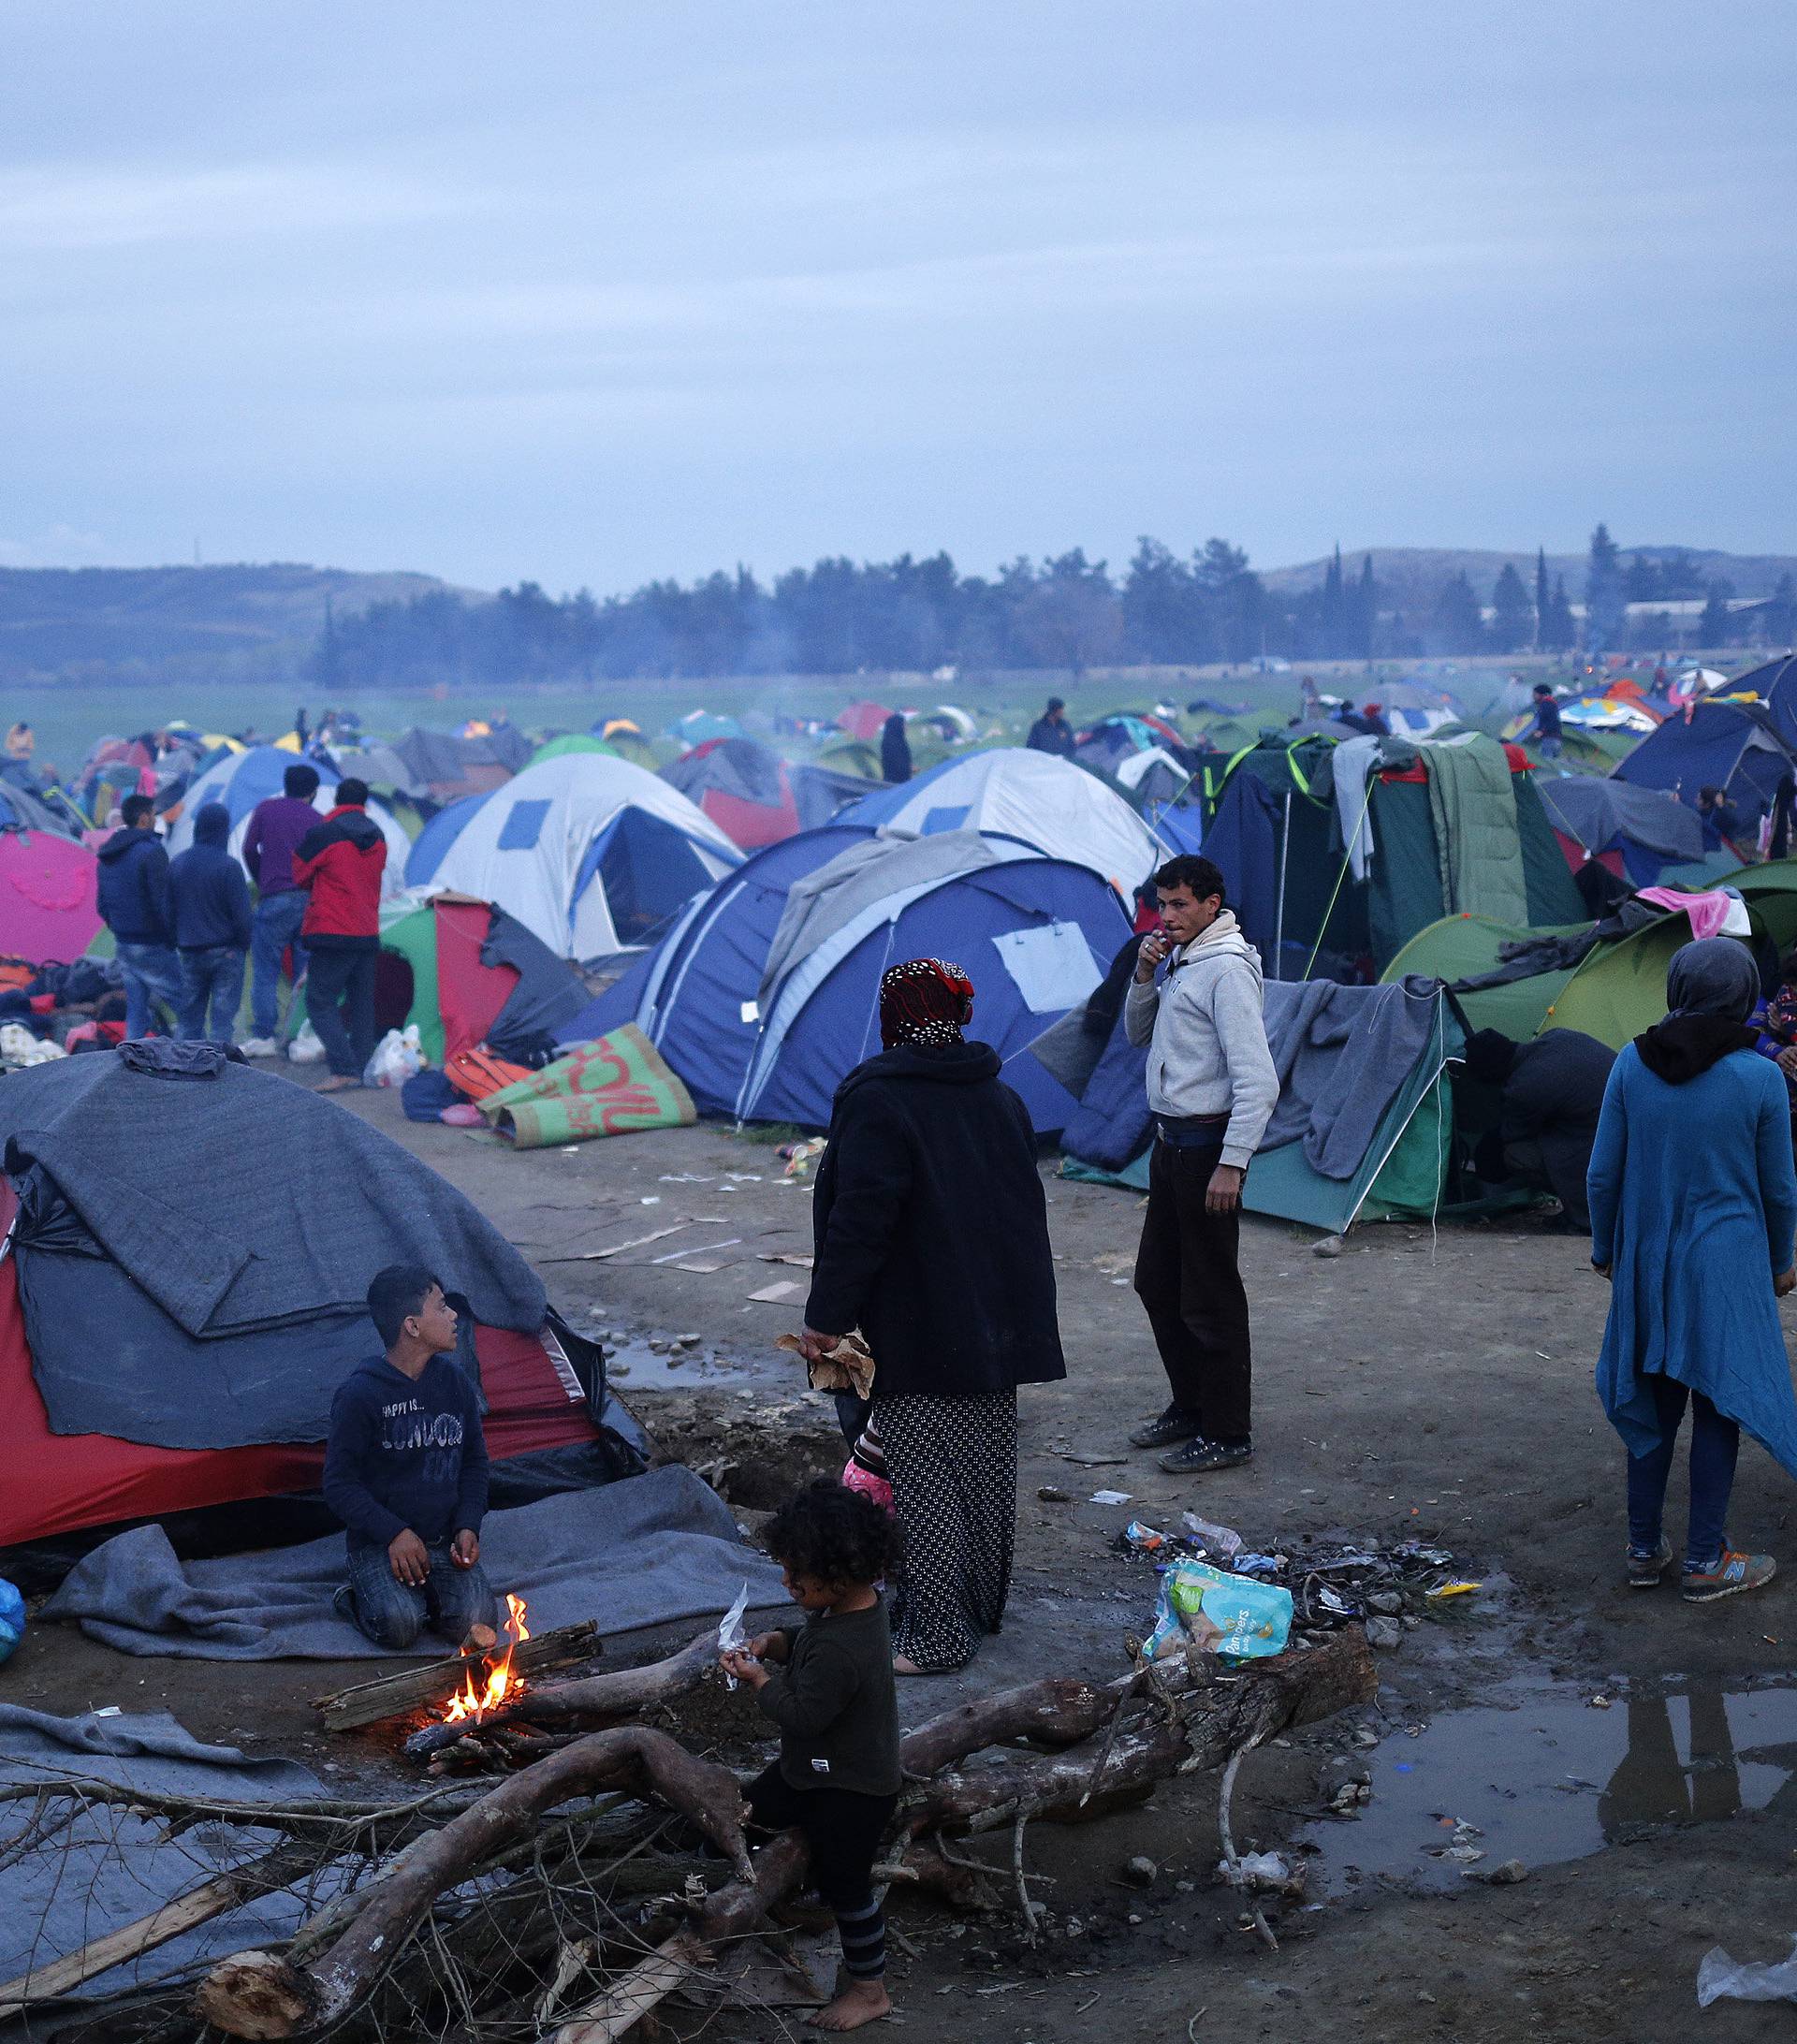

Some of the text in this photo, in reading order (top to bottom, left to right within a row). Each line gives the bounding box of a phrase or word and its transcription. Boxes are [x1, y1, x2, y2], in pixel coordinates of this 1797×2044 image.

[382, 1401, 407, 1418] HAPPY
[1723, 1561, 1746, 1582] N
[1225, 1610, 1249, 1656] Pampers
